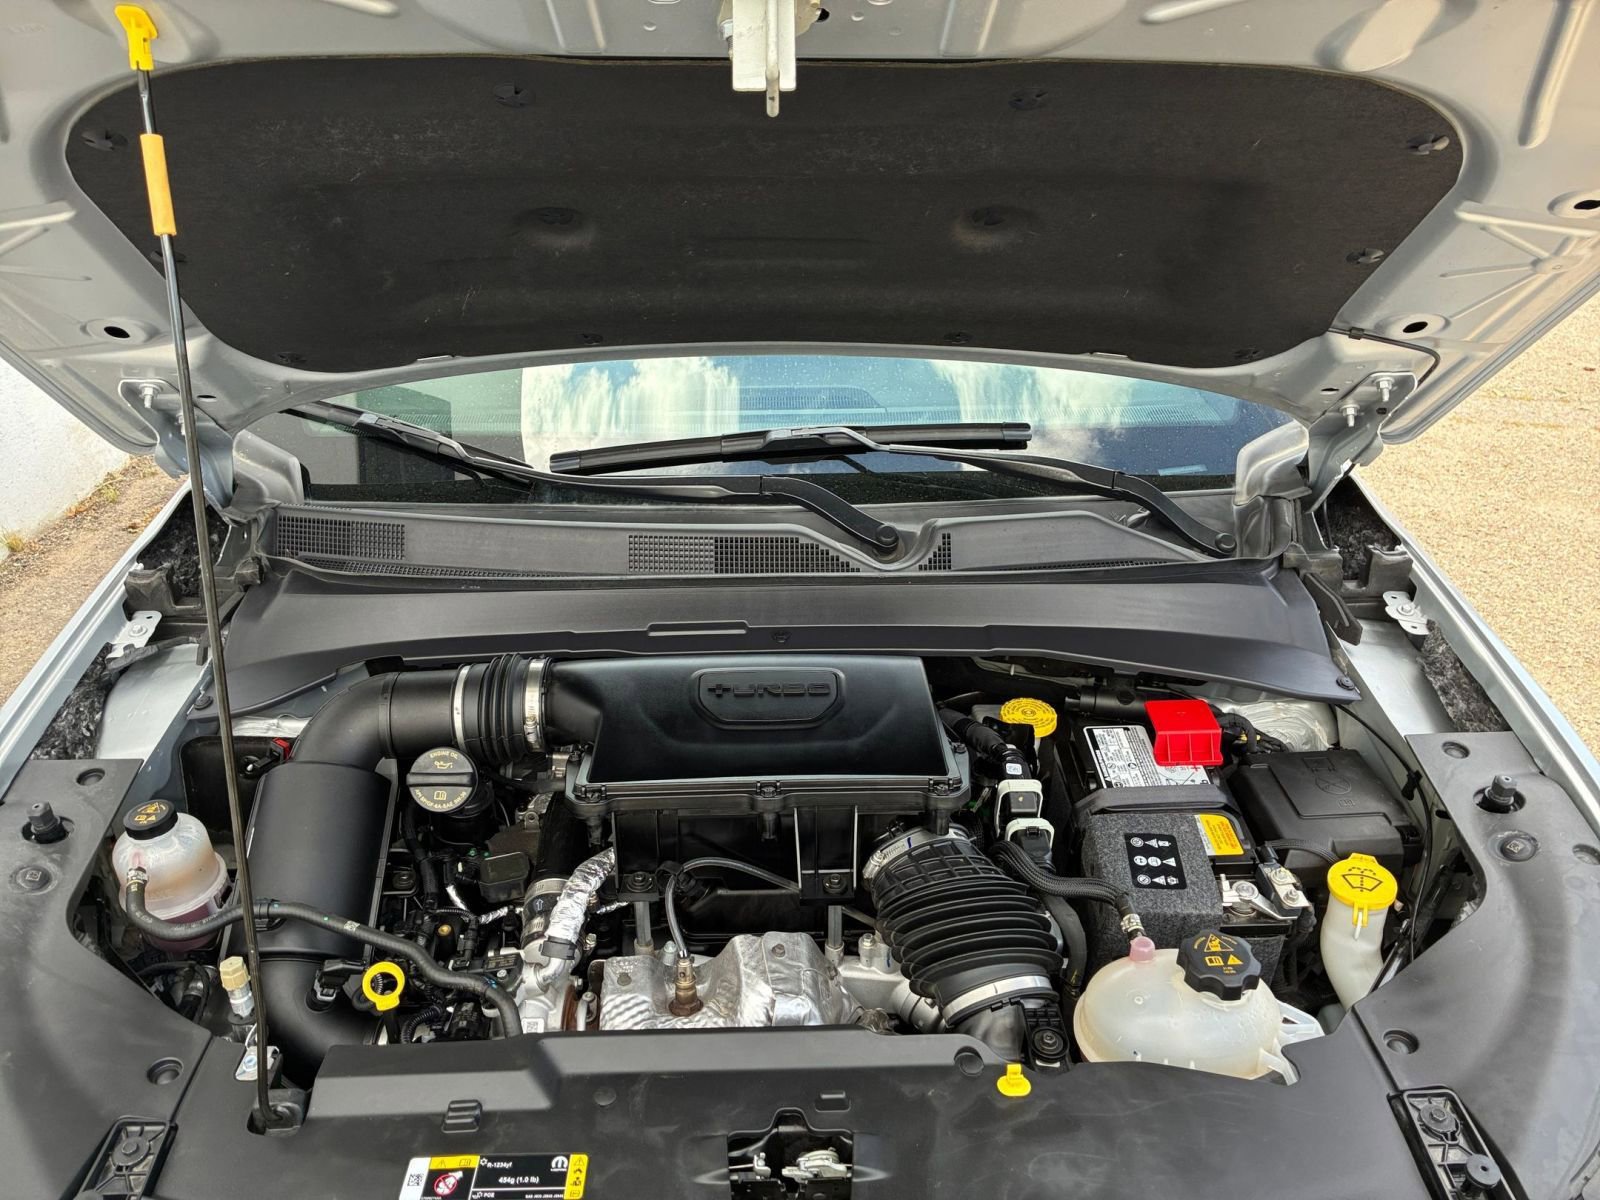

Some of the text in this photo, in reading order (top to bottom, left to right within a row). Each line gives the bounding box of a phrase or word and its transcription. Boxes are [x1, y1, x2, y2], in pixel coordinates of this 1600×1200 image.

[430, 750, 458, 760] ENGINE OIL
[486, 1161, 512, 1169] R-1234yf
[498, 1176, 540, 1185] 454g (1.0 lb)
